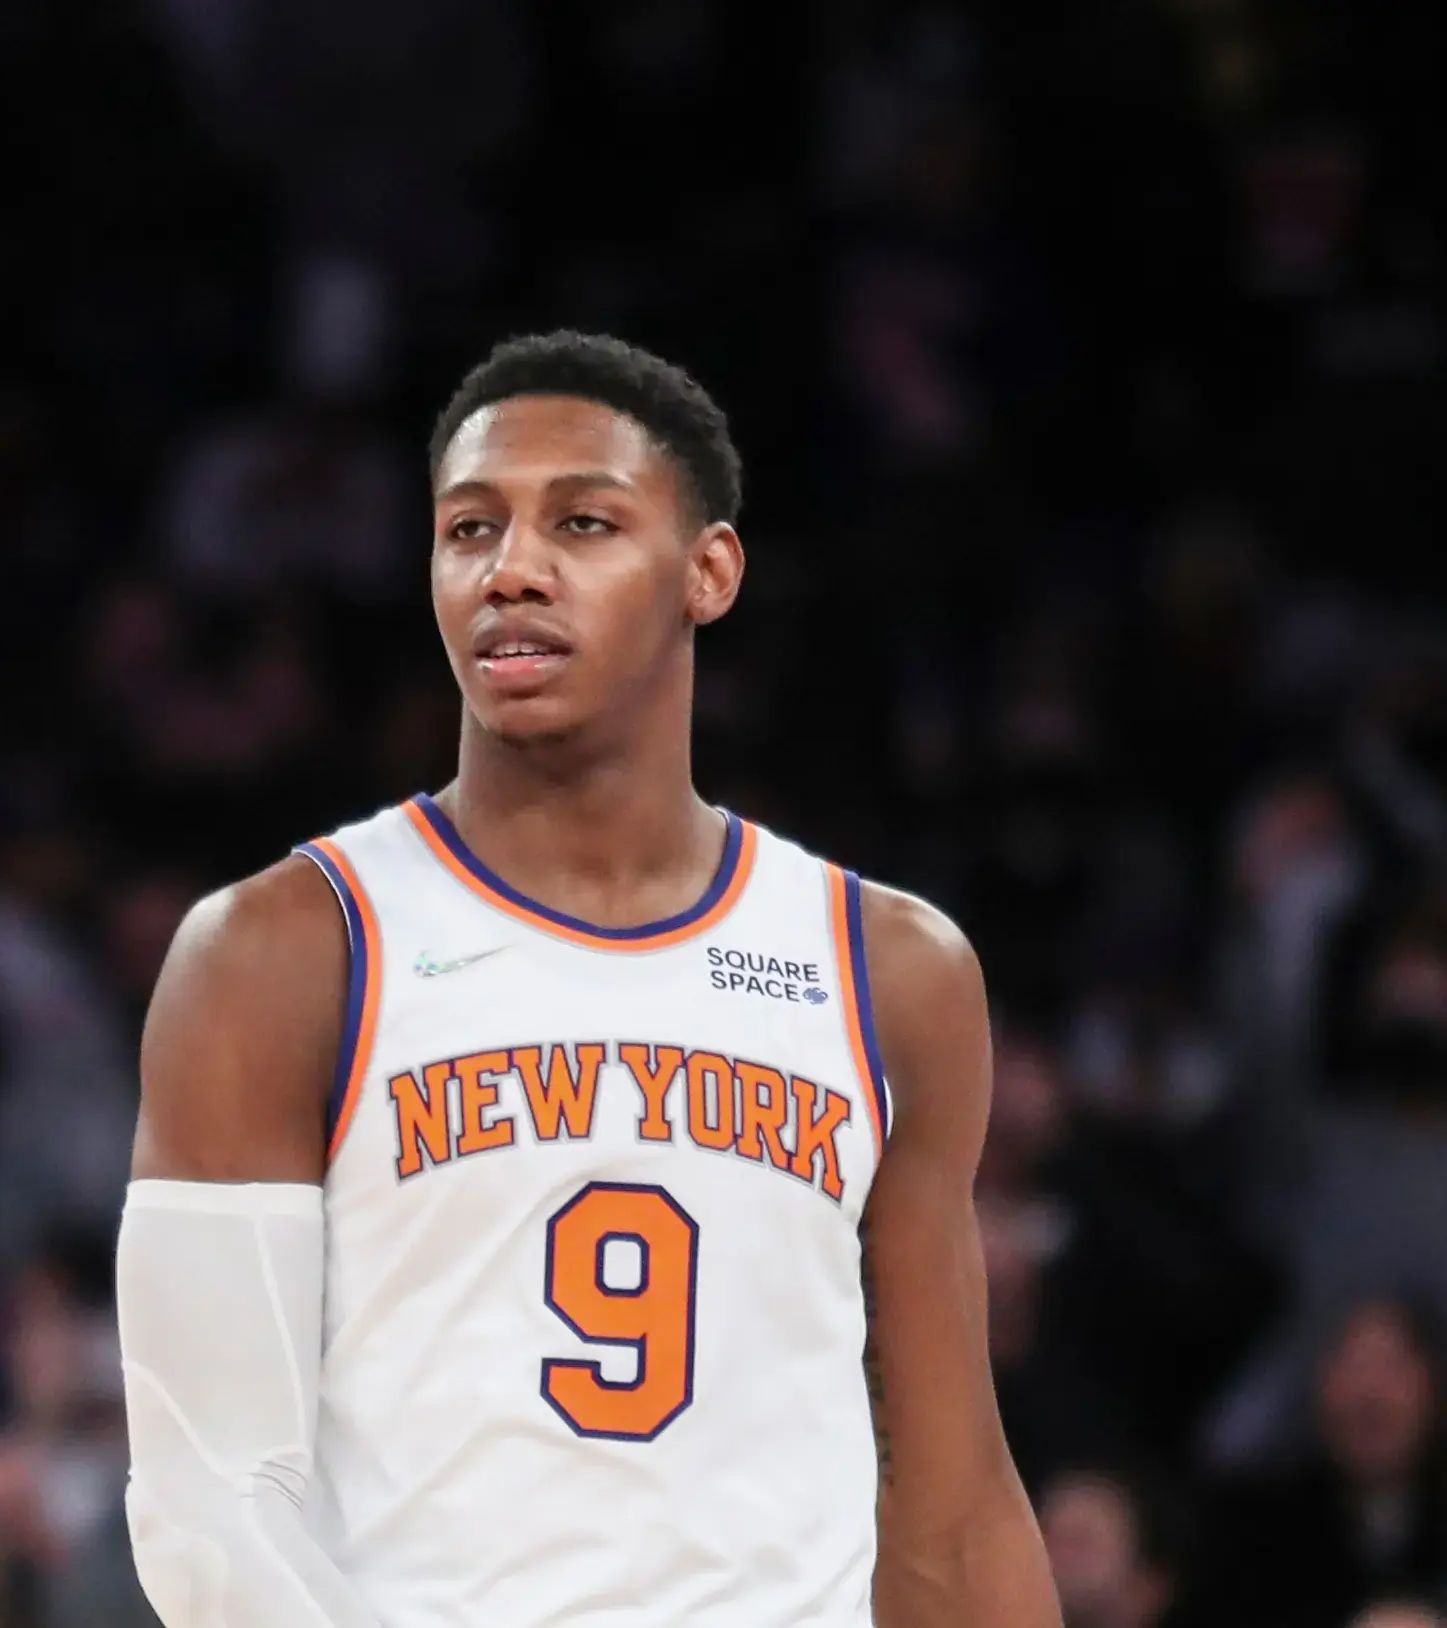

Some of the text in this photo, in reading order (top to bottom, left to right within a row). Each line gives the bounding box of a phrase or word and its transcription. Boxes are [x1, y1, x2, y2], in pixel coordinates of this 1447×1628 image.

[707, 947, 820, 982] SQUARE
[710, 970, 800, 1002] SPACE
[387, 1042, 852, 1204] NEW YORK
[540, 1181, 700, 1442] 9
